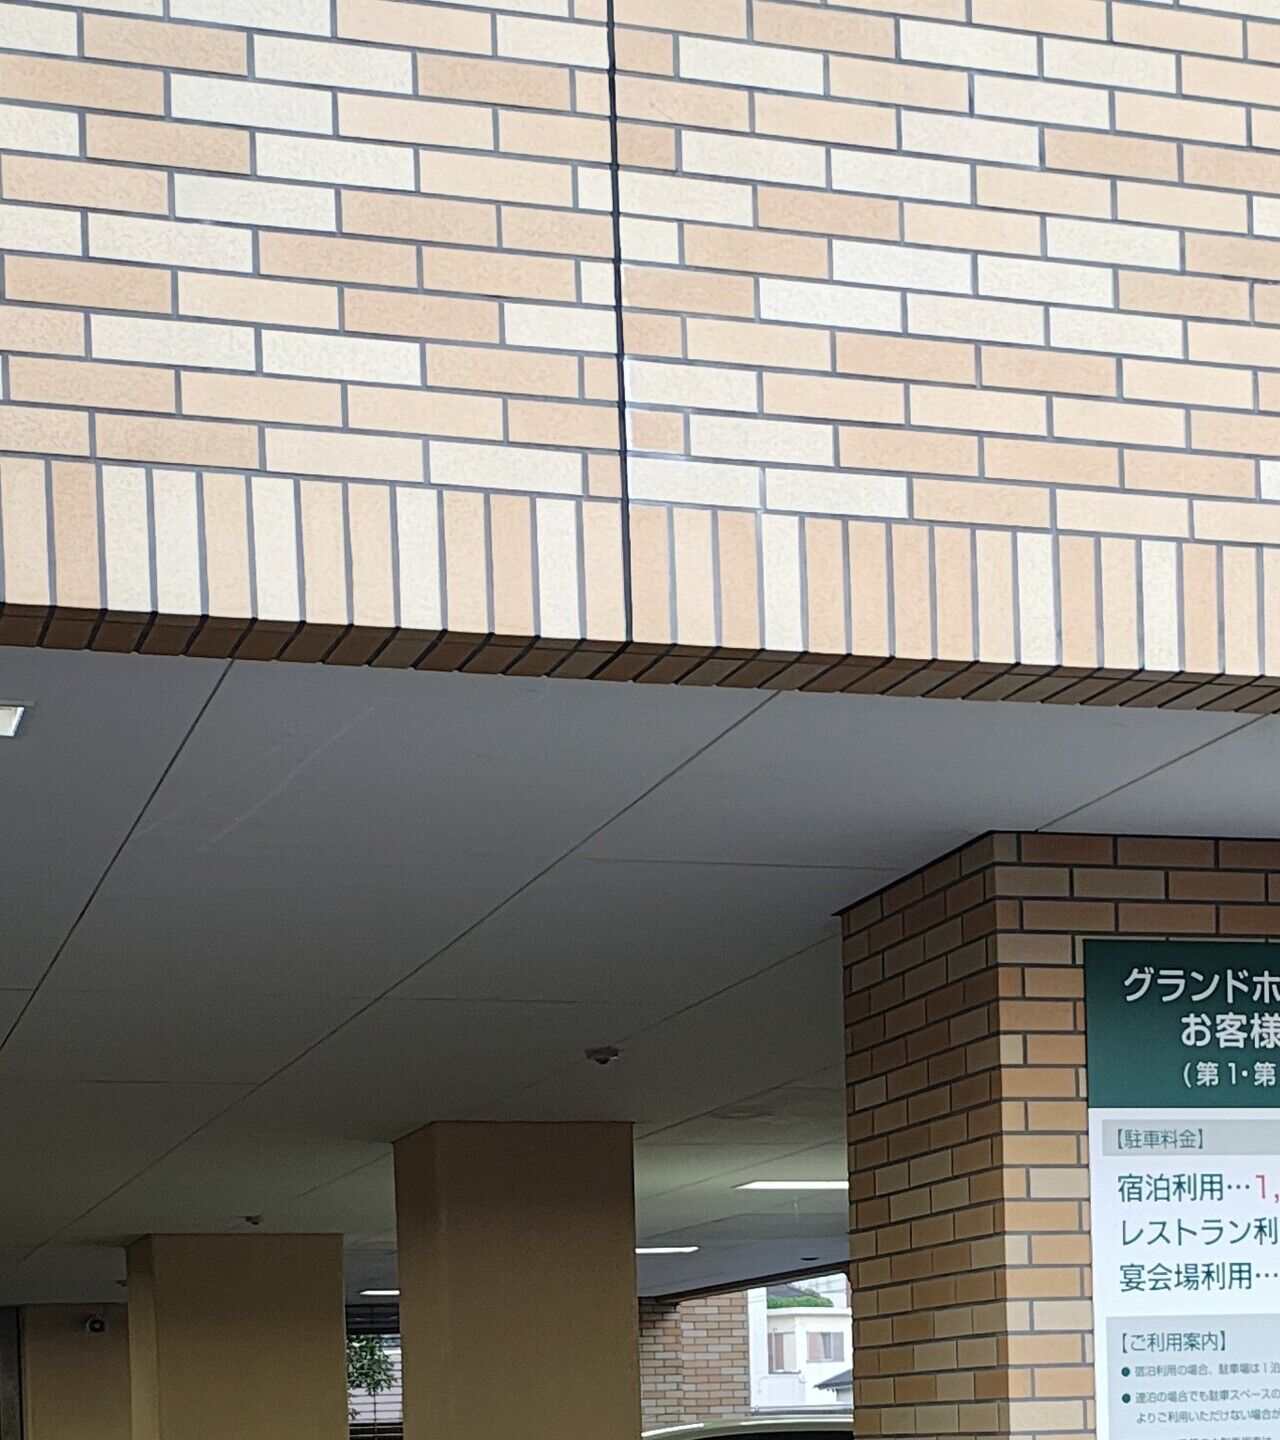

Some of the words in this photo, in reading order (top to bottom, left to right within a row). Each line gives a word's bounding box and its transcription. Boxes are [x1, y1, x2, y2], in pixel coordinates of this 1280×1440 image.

[1117, 1128, 1203, 1150] 【駐車料金】
[1122, 1330, 1226, 1353] 【ご利用案内】
